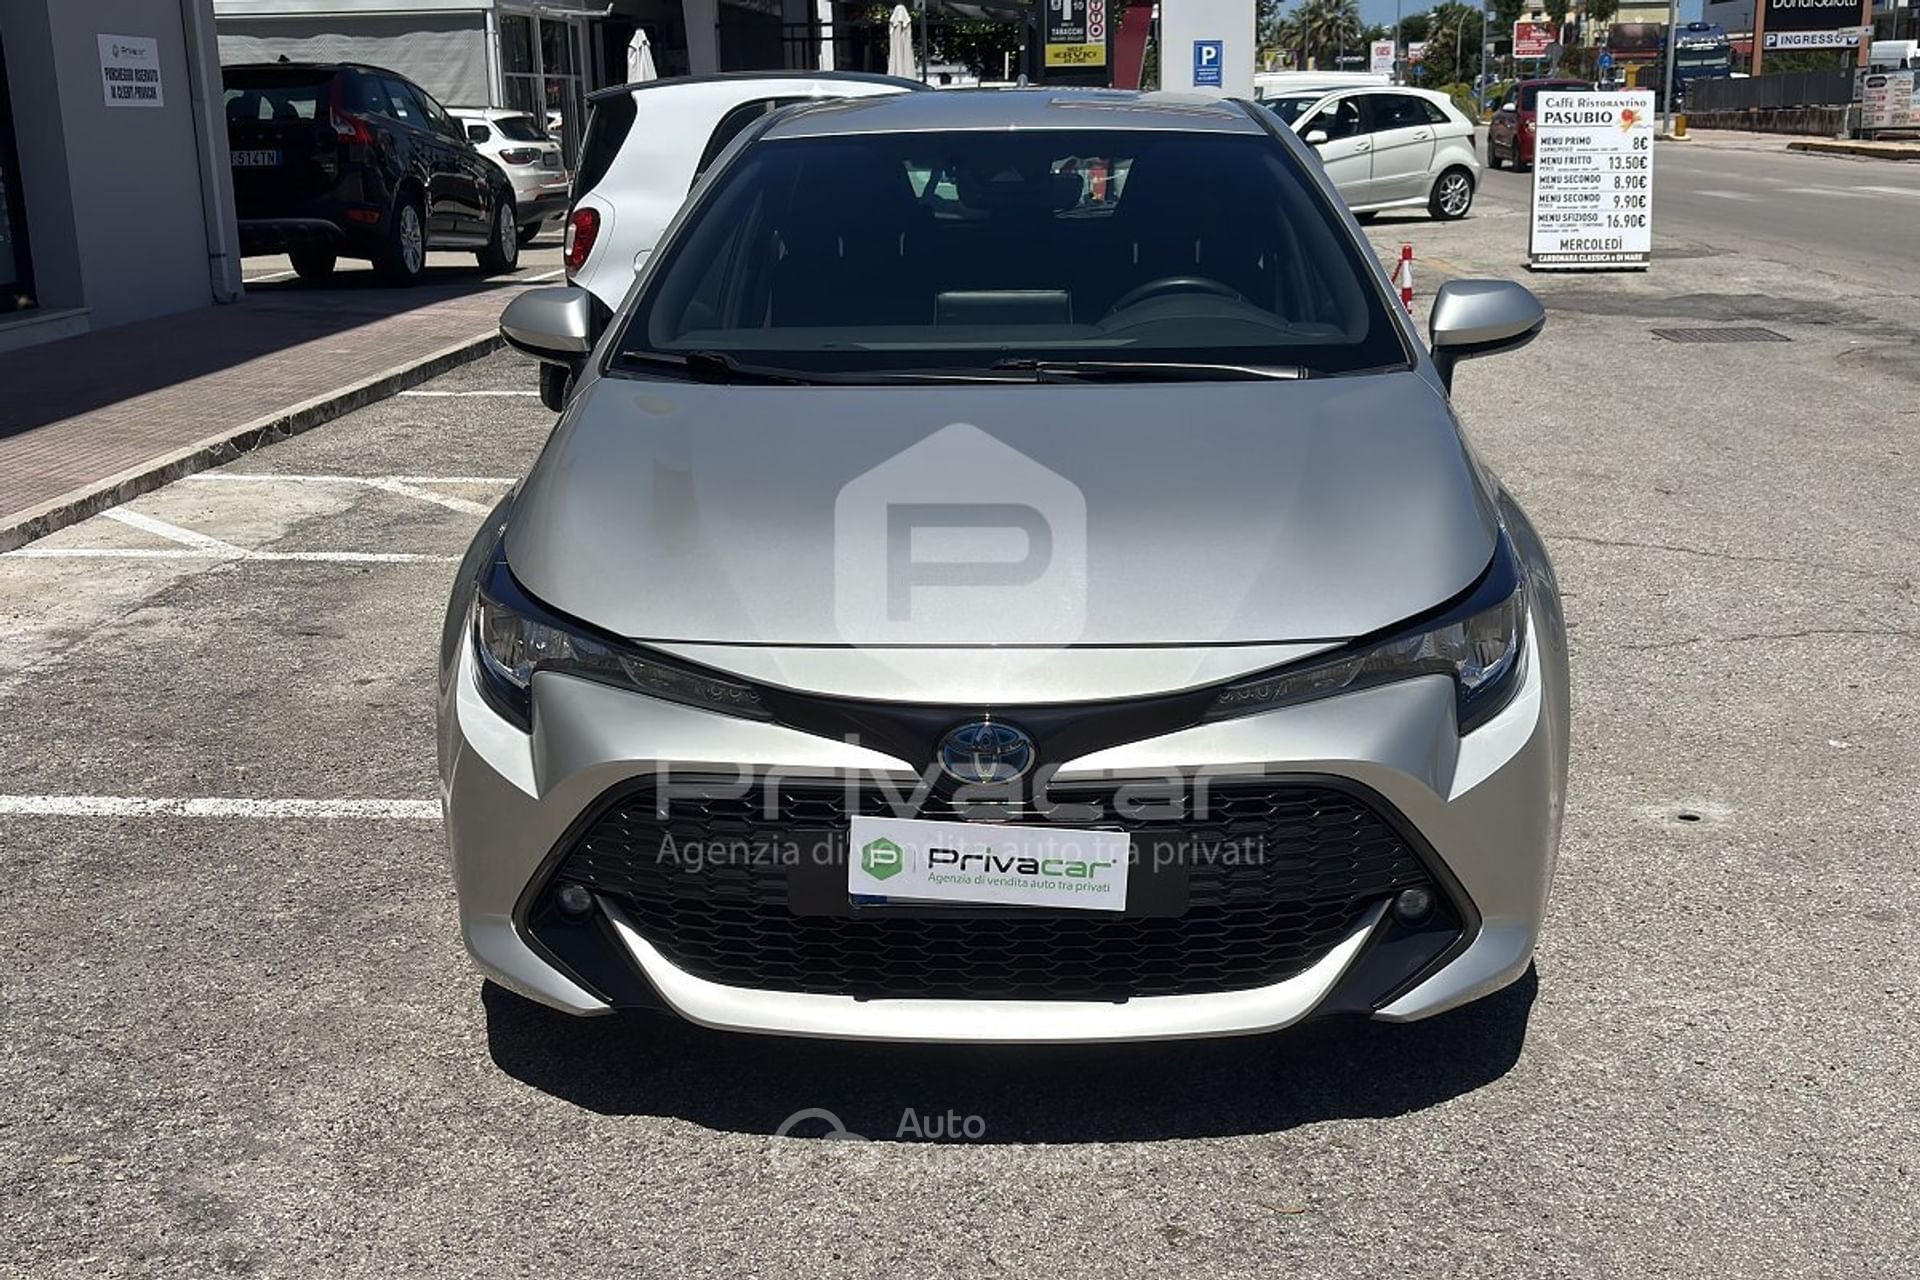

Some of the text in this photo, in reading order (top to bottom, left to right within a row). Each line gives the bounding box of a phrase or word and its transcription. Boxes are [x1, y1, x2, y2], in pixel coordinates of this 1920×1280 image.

[1780, 34, 1843, 45] INGRESSO
[1202, 46, 1217, 65] P
[1544, 111, 1613, 124] PASUBIO
[1540, 136, 1648, 150] MENU PRIMO 8€
[1540, 156, 1563, 165] MENU
[1564, 156, 1592, 165] FRITTO
[1608, 156, 1648, 170] 13.50€
[1539, 174, 1648, 189] MENU SECONDO 8.90€
[1539, 193, 1647, 209] MENU SECONDO 9.90€
[1538, 213, 1561, 222] MENU
[1562, 212, 1598, 222] SFIZIOSO
[1607, 214, 1647, 228] 16.90€
[1579, 253, 1610, 262] CLASSICA
[928, 847, 1116, 879] Privacar
[928, 871, 1111, 893] Agenzia di vendita auto tra privati
